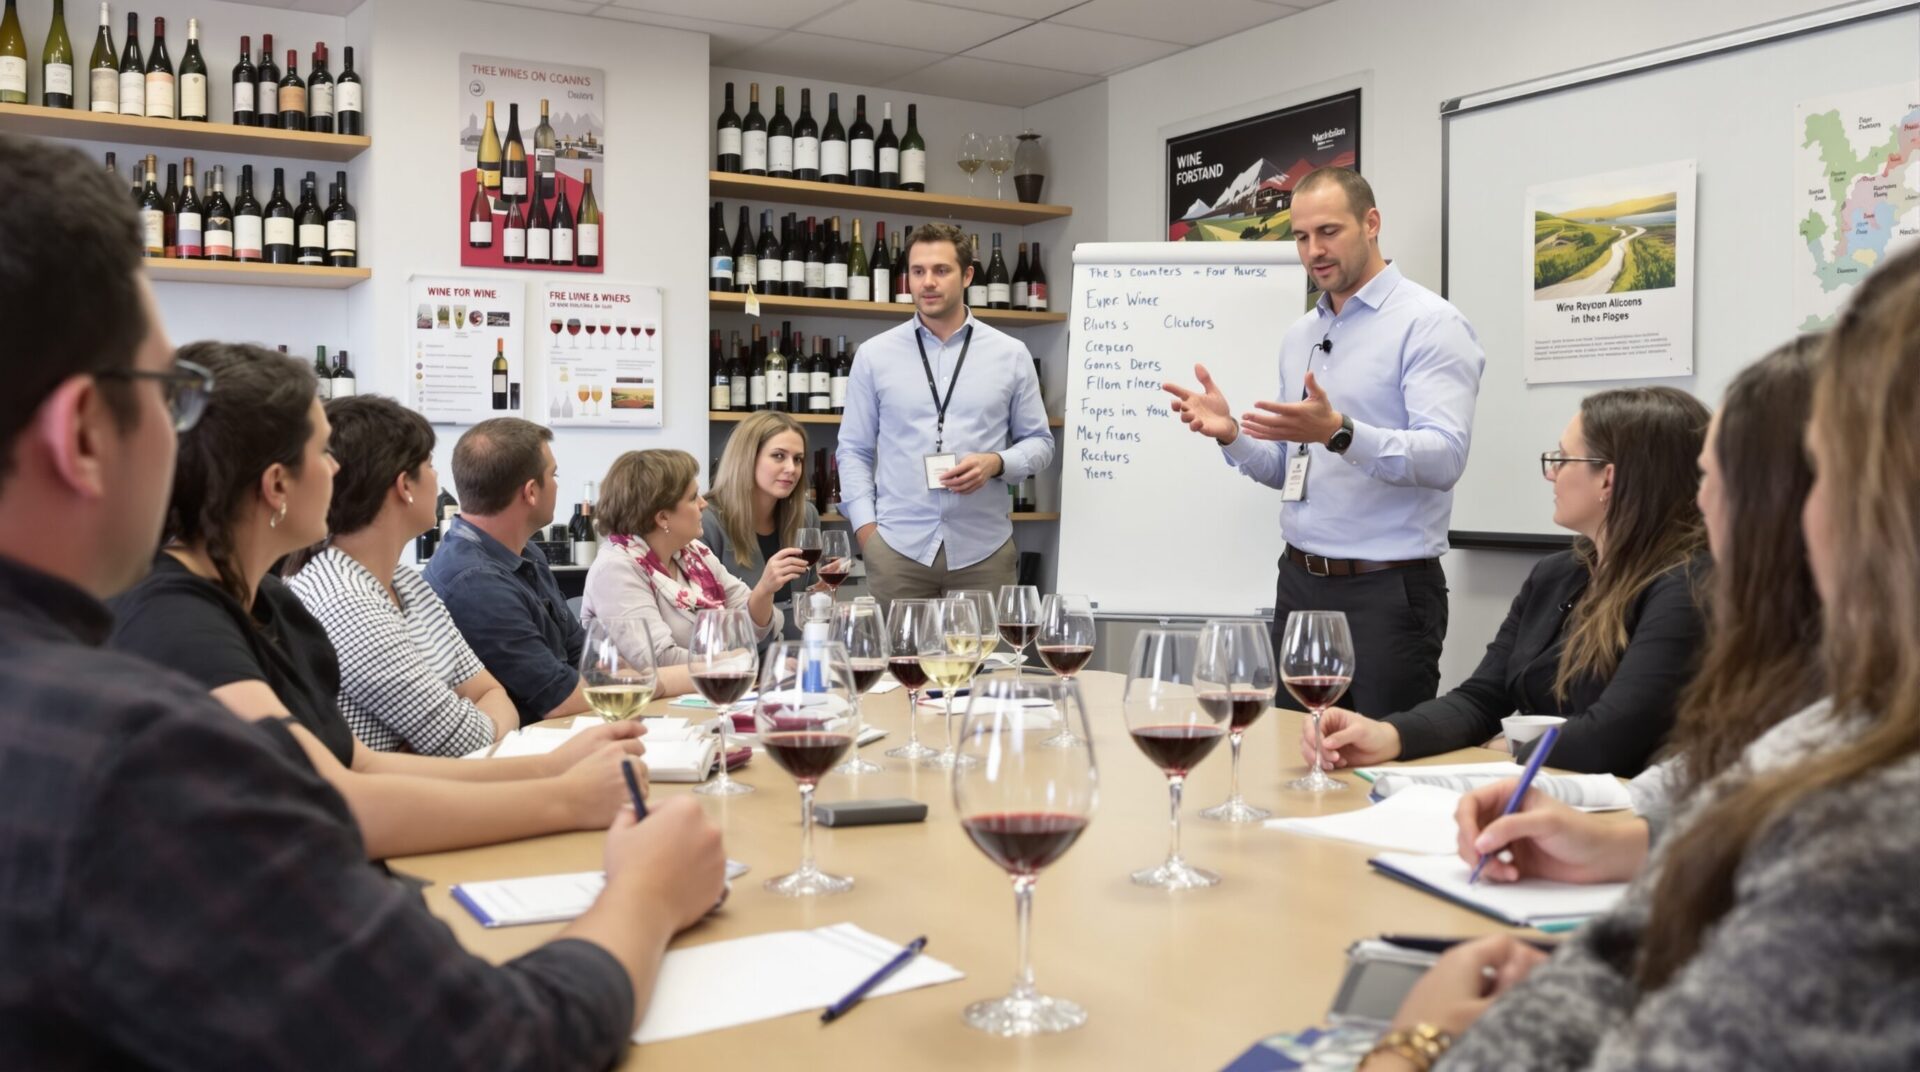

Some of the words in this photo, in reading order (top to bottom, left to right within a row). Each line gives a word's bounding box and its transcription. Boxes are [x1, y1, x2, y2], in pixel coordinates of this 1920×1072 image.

[472, 64, 496, 76] THEE
[499, 67, 529, 80] WINES
[531, 71, 546, 82] ON
[1176, 151, 1203, 169] WINE
[1176, 163, 1224, 186] FORSTAND
[1089, 267, 1109, 279] The
[427, 287, 451, 296] WINE
[473, 289, 497, 299] WINE
[549, 291, 566, 300] FRE
